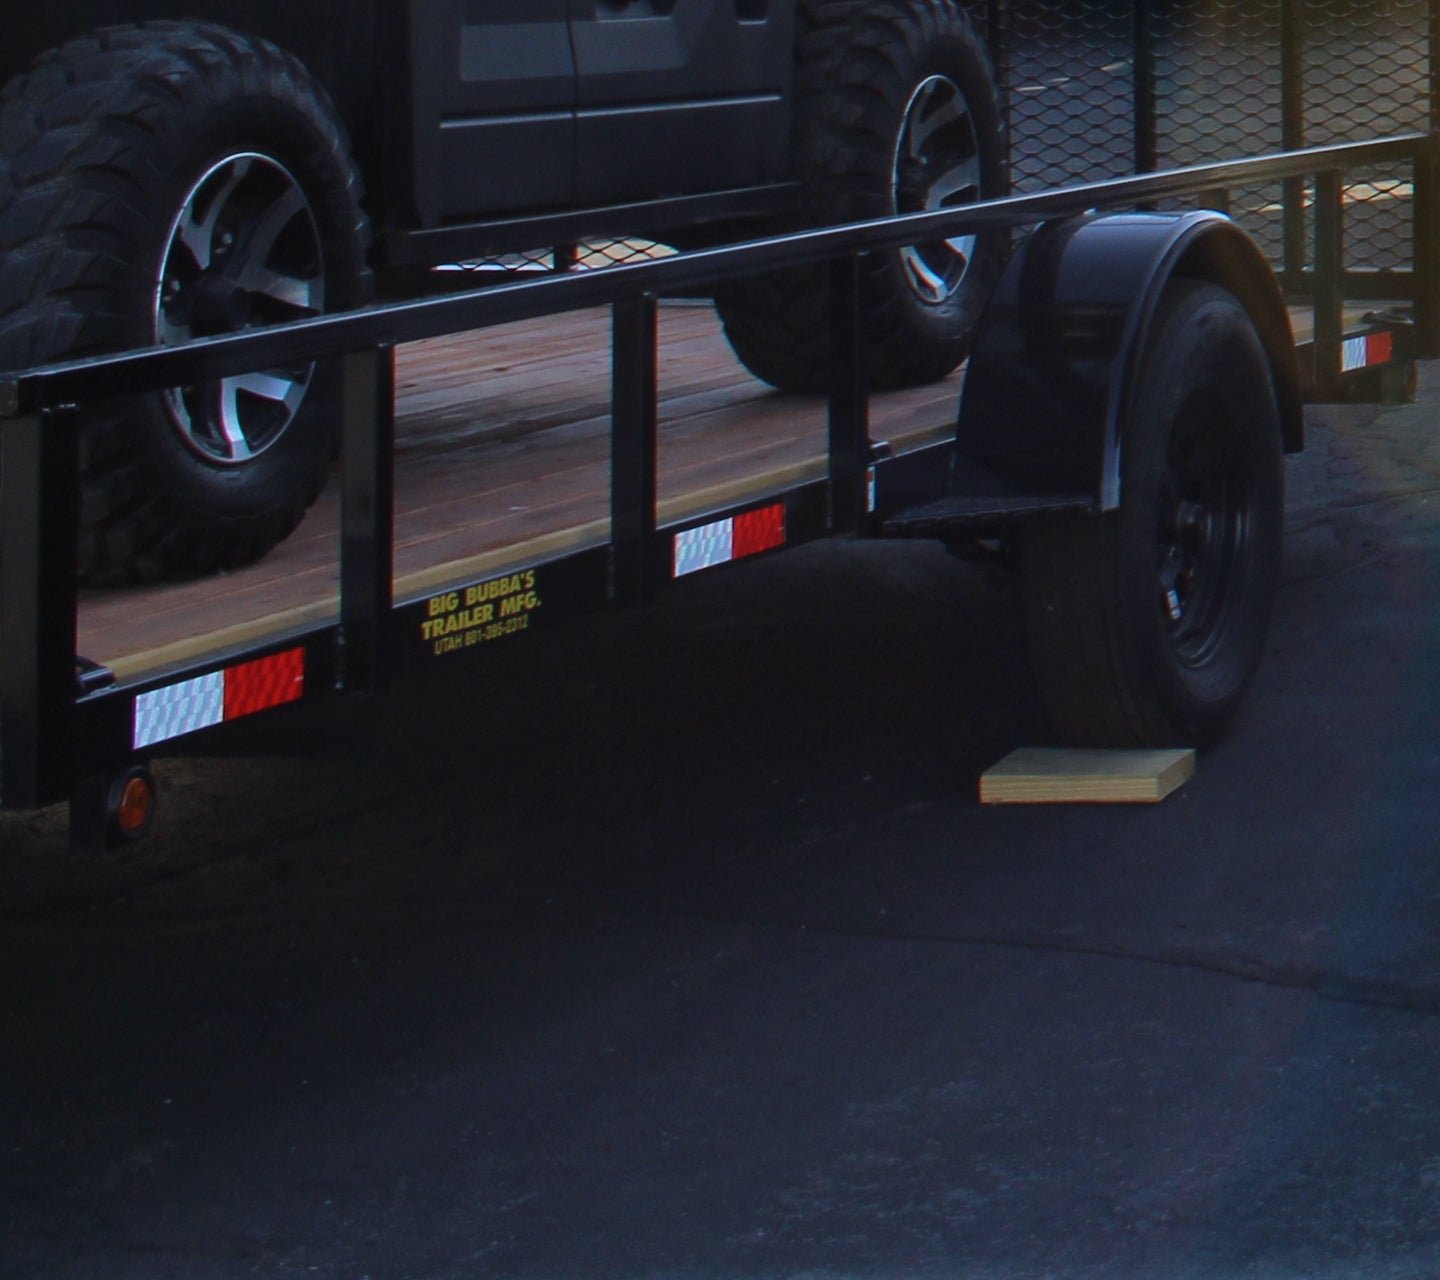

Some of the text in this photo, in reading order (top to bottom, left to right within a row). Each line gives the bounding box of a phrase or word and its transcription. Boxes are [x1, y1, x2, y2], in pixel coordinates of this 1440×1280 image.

[421, 590, 542, 640] TRAILER MFG.
[429, 570, 535, 617] BIG BUBBA'S
[434, 635, 463, 655] UTAH
